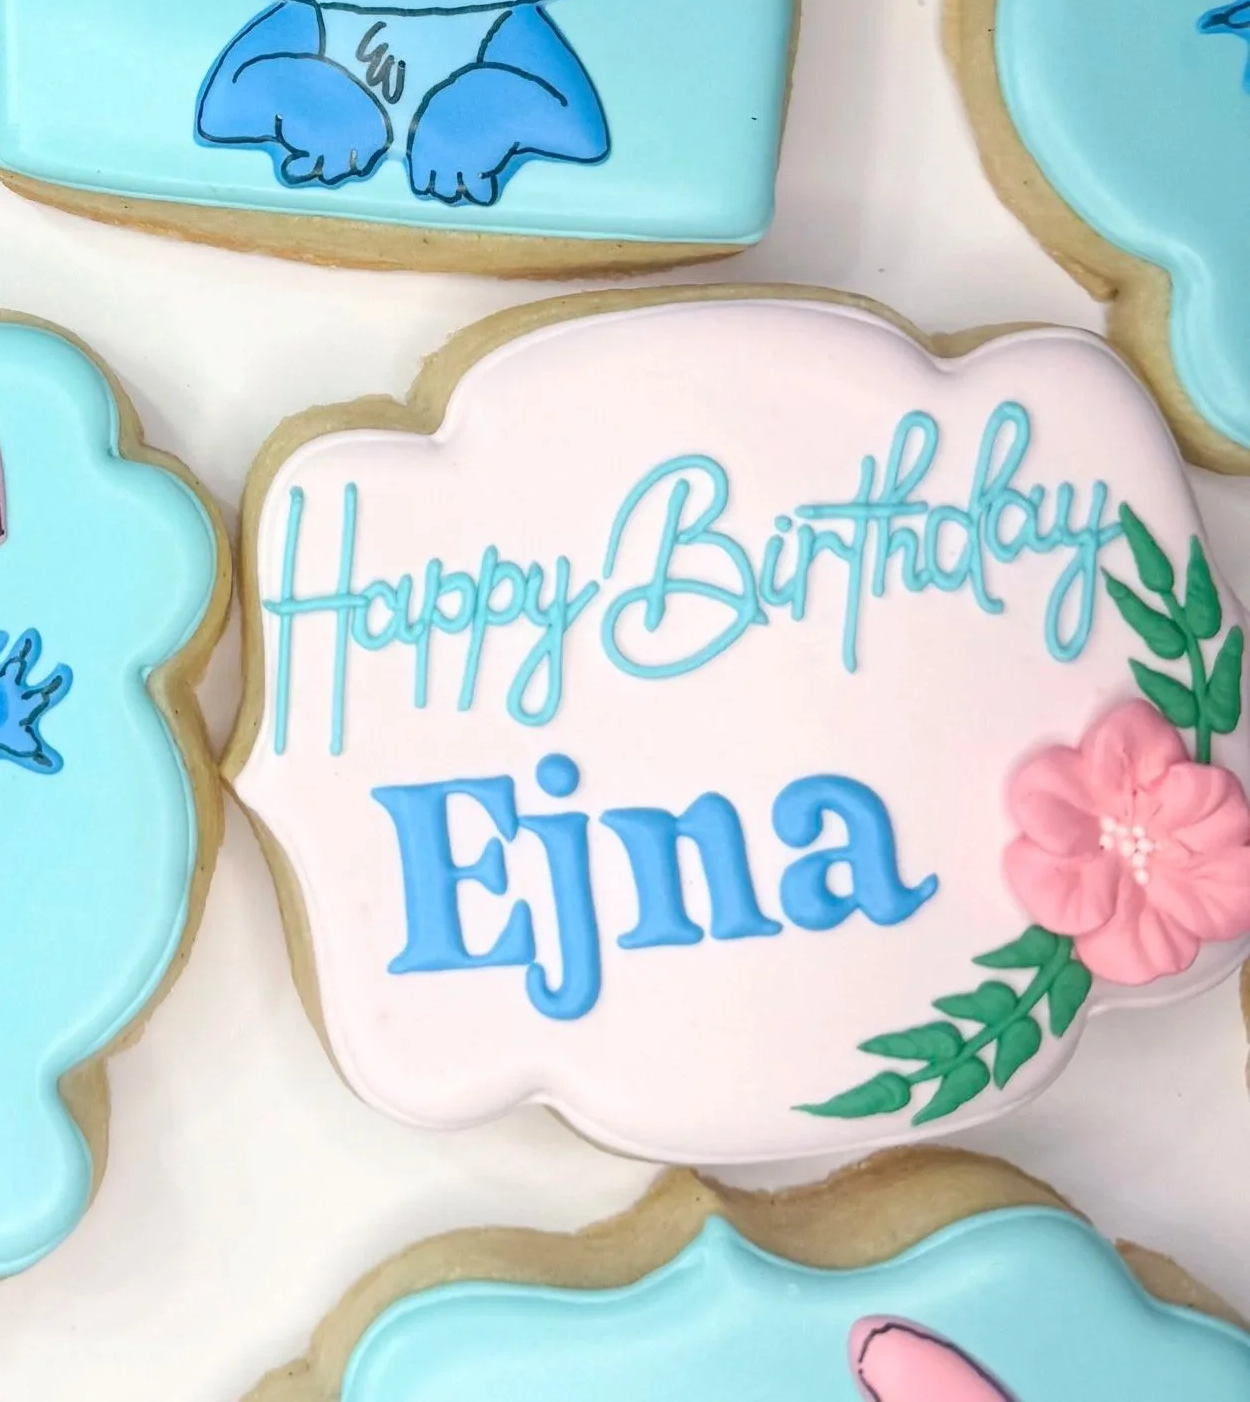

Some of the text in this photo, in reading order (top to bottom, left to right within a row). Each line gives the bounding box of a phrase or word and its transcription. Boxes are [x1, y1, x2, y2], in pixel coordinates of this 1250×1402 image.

[263, 400, 1124, 756] Happy Birthday
[369, 751, 940, 1020] Ejna
